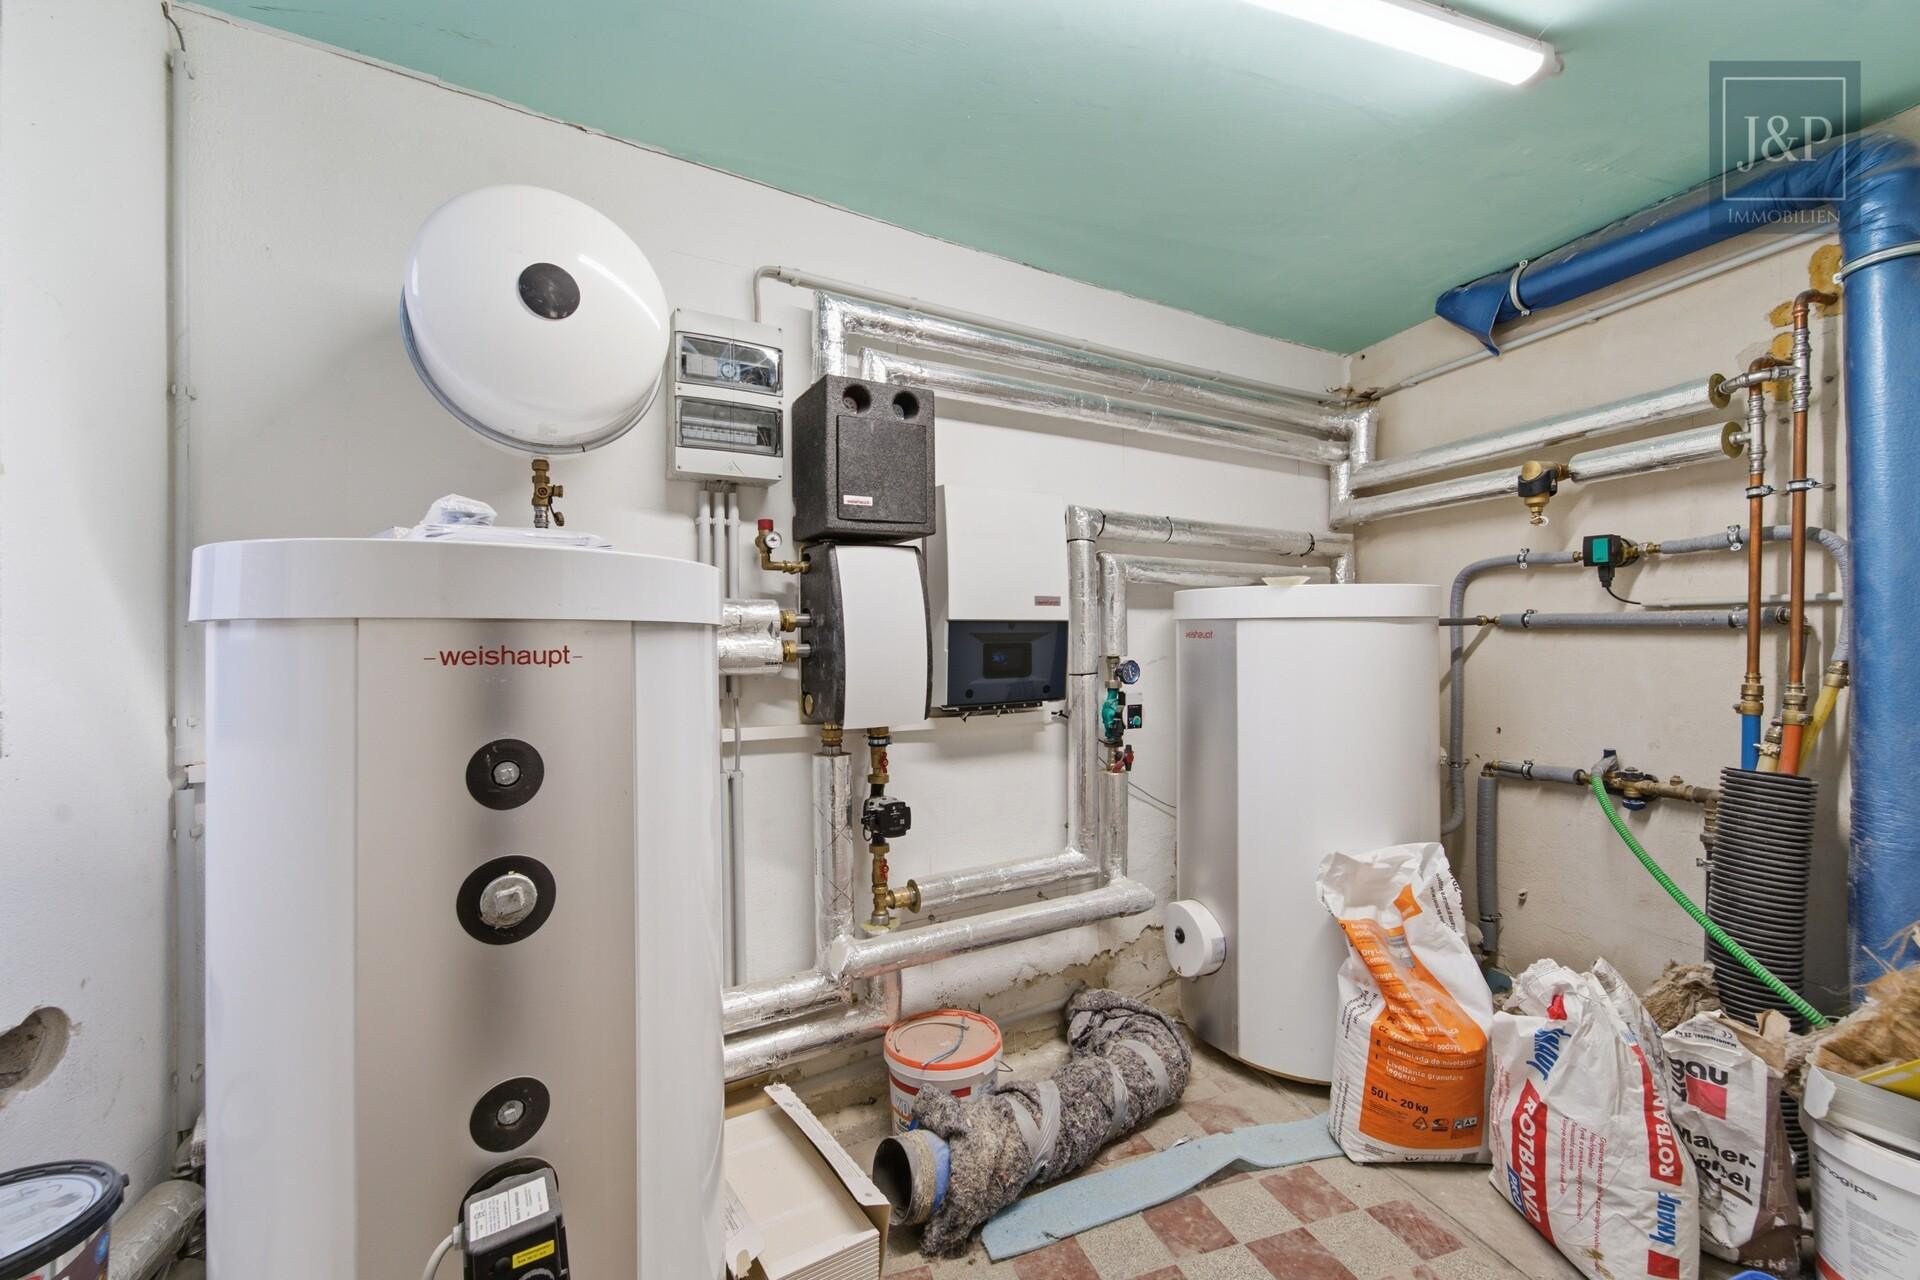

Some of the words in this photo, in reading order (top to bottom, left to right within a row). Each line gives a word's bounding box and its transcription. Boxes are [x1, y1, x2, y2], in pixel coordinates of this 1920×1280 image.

[1370, 1086, 1384, 1099] 50
[1400, 1098, 1414, 1110] 20
[1415, 1102, 1429, 1115] kg
[1518, 1096, 1542, 1224] ROTBAND
